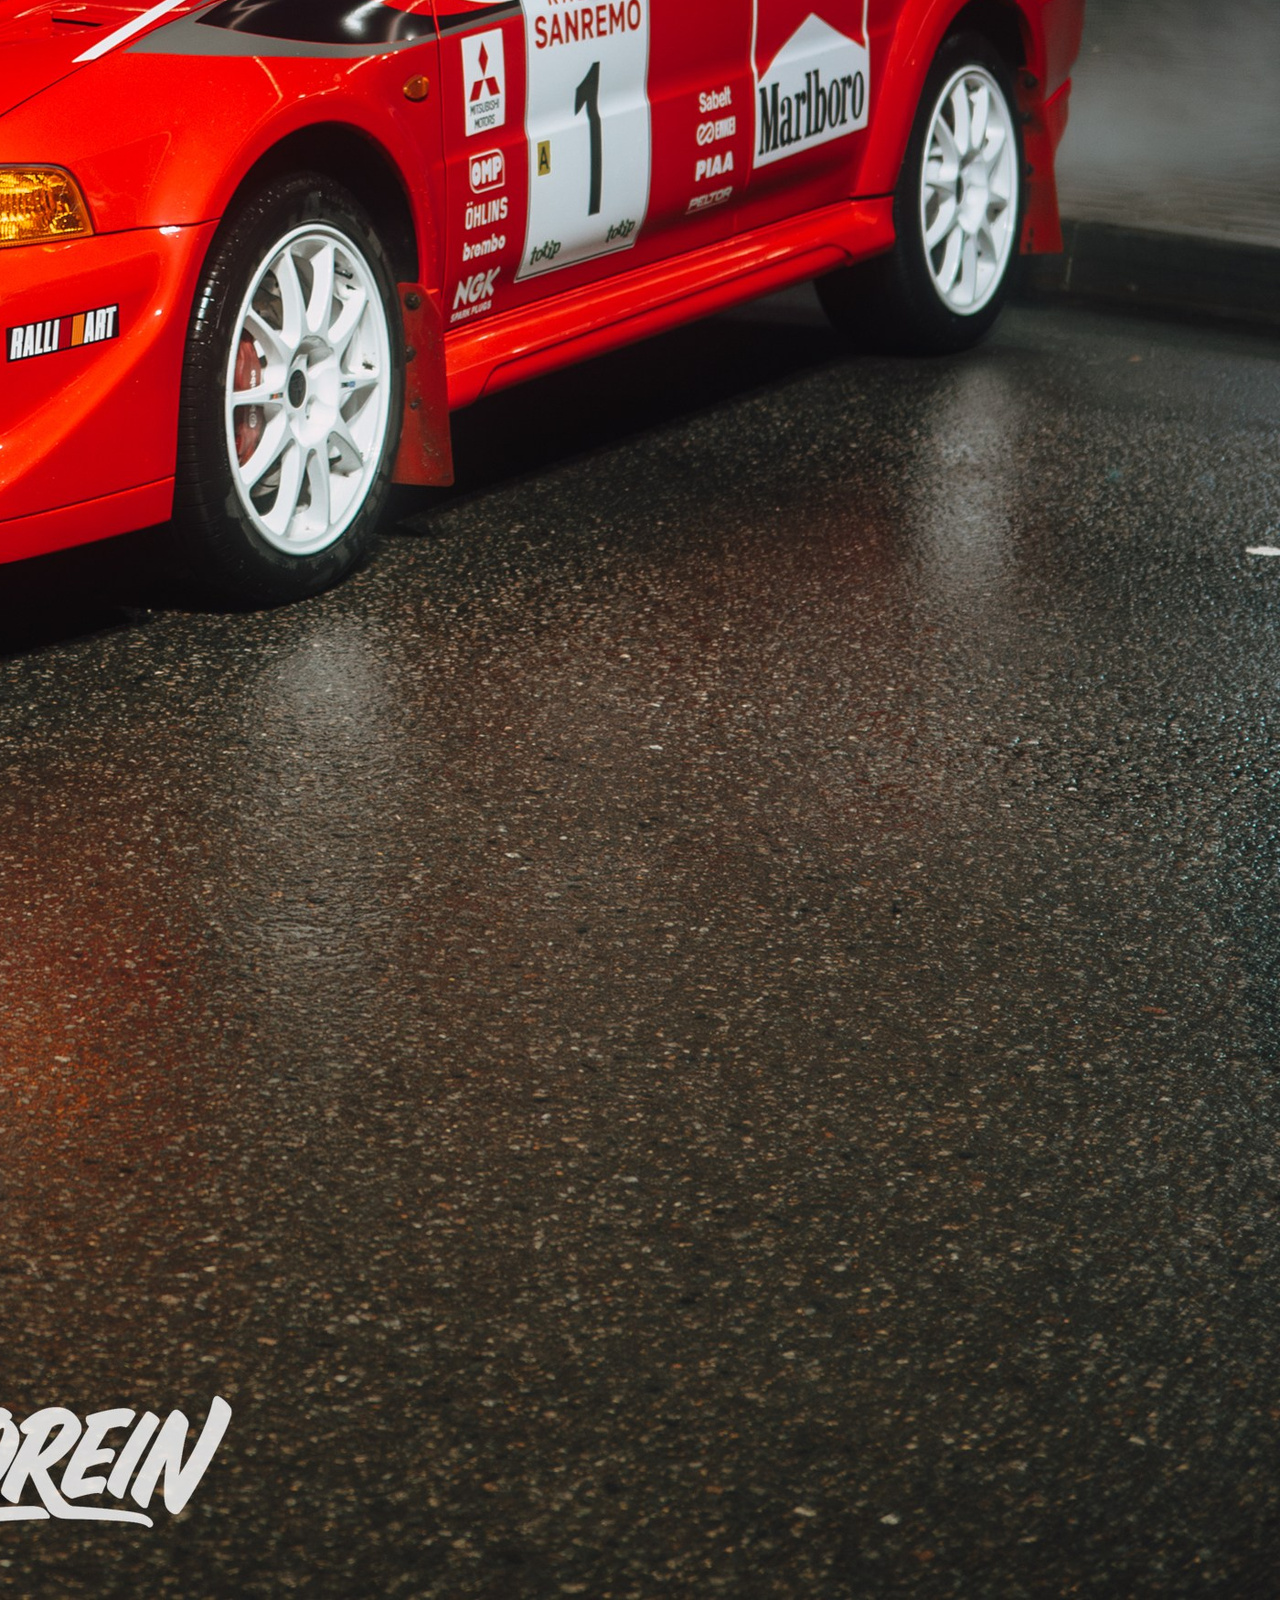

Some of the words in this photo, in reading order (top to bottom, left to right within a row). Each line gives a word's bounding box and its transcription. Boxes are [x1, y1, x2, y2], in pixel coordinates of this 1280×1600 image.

[470, 99, 500, 116] MITSUBISHI
[699, 85, 732, 113] Sabelt
[758, 69, 865, 156] Marlboro
[474, 115, 496, 130] MOTORS
[575, 61, 602, 216] 1
[471, 156, 503, 187] OMP
[538, 145, 550, 171] A
[695, 151, 734, 182] PIAA
[688, 186, 734, 211] PELTOR
[465, 197, 508, 230] ÖHLINS
[462, 234, 506, 261] brembo
[452, 266, 501, 310] NGK
